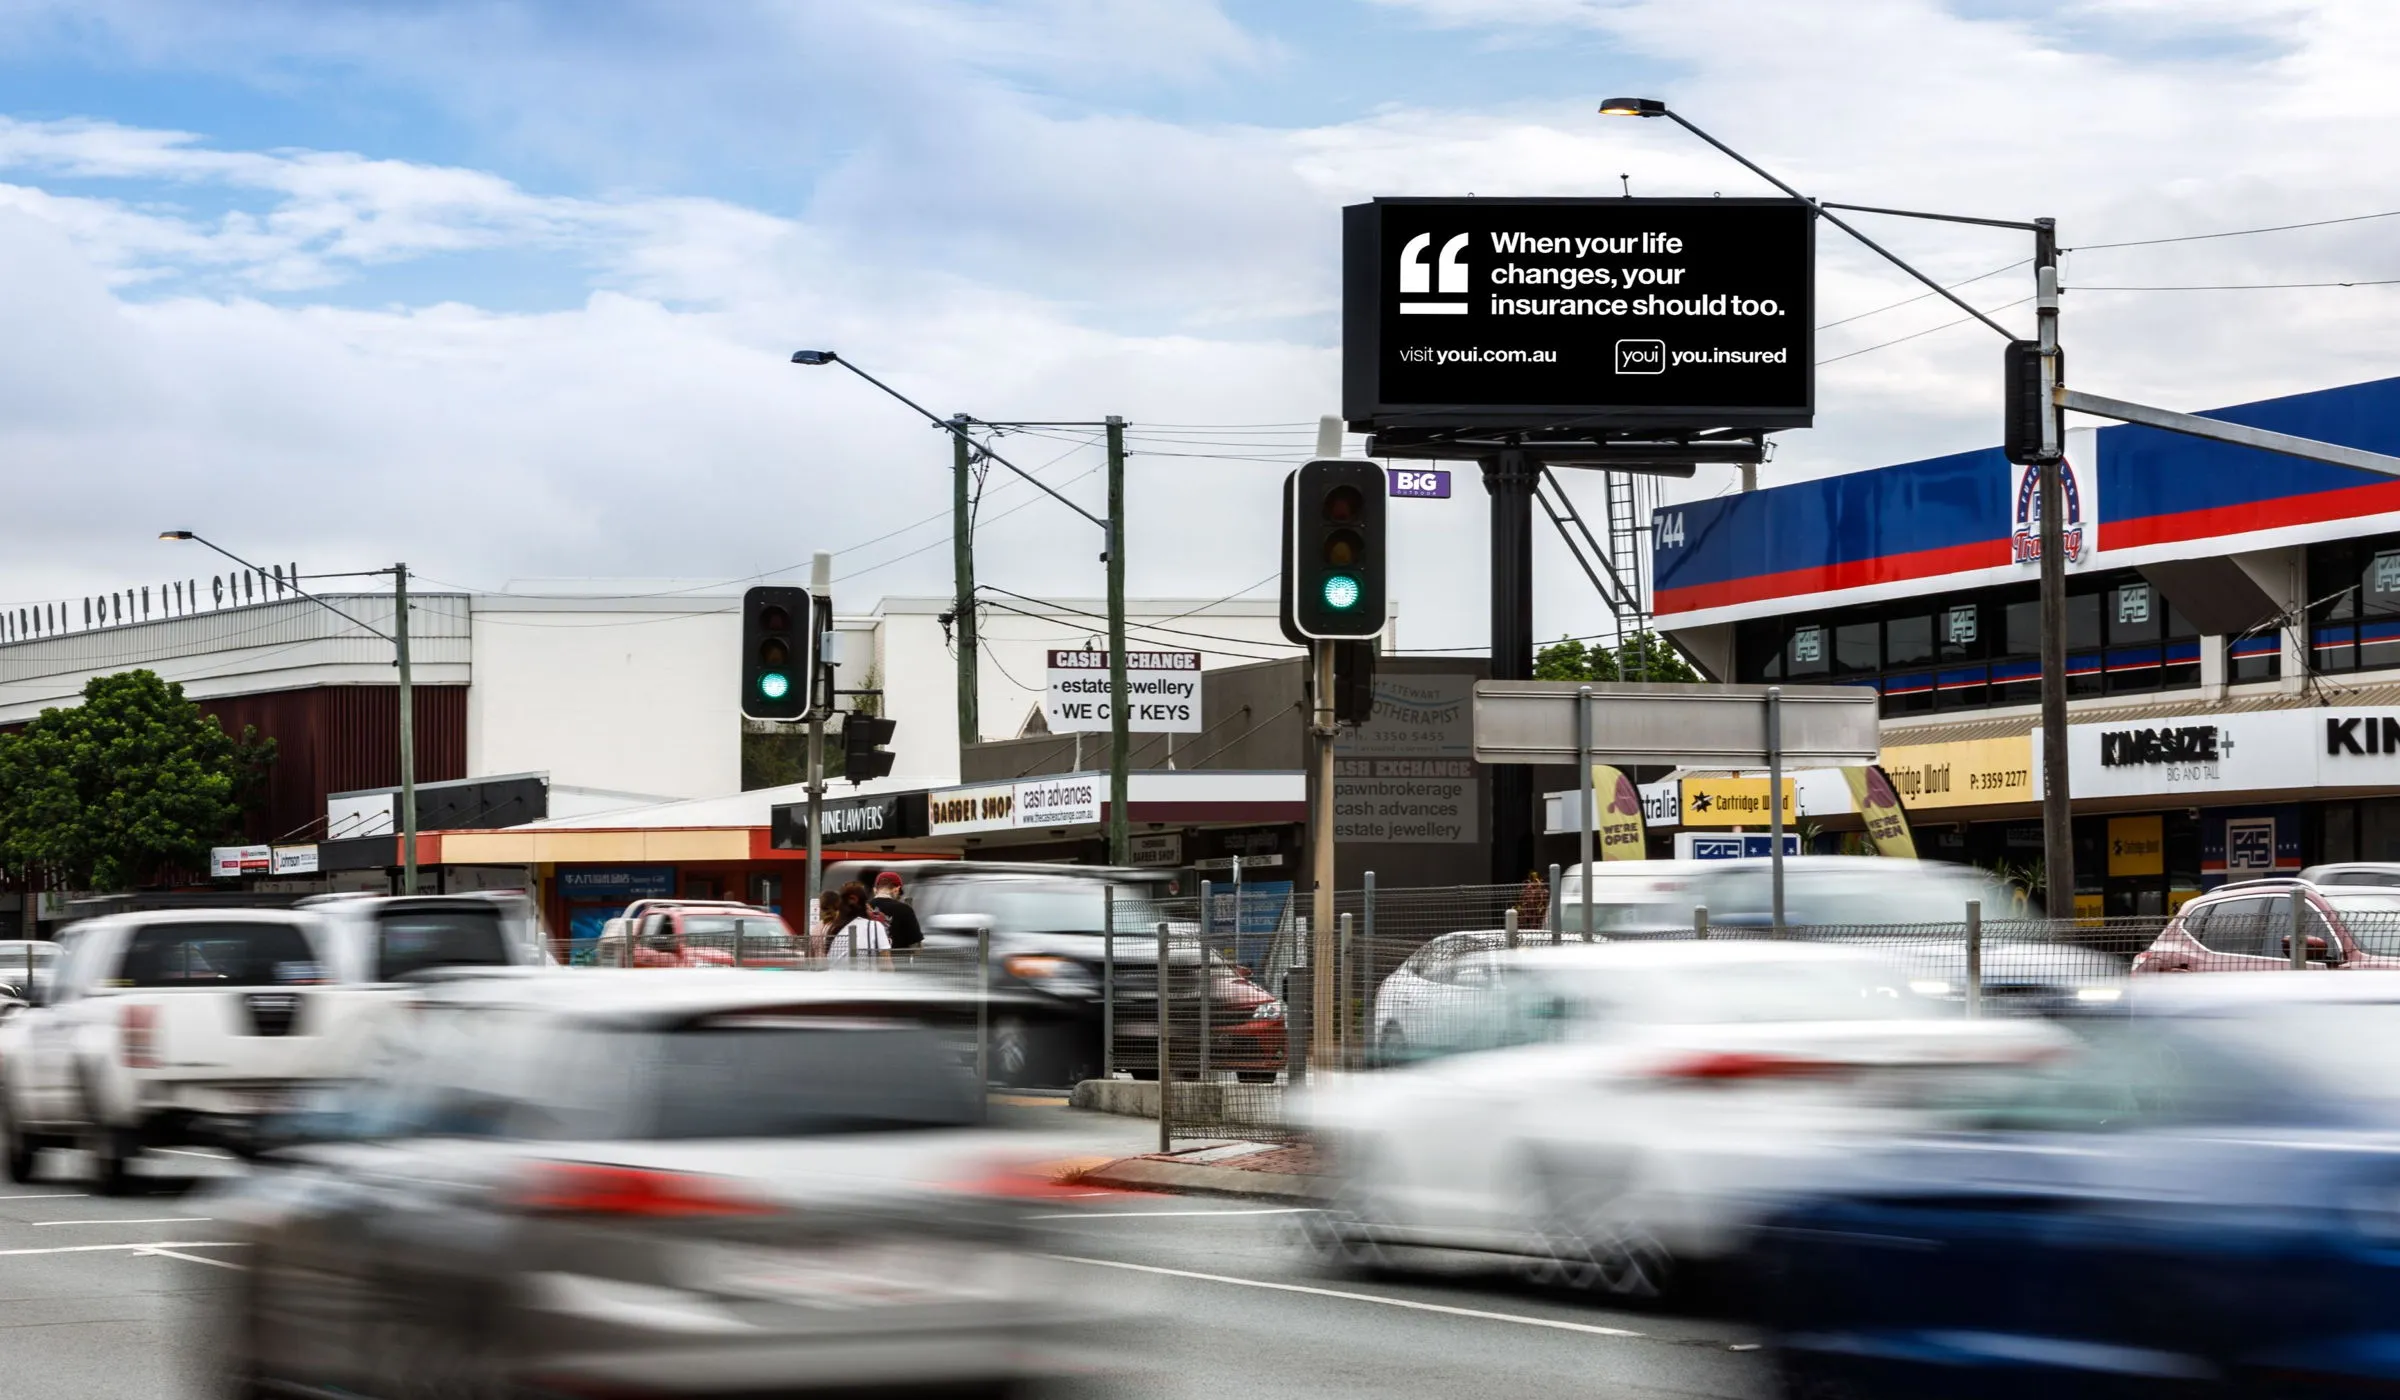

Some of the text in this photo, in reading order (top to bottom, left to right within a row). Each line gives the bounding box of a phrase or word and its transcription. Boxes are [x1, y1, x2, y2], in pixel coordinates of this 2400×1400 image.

[1491, 232, 1683, 258] When your life
[1491, 264, 1685, 289] changes, your
[1491, 294, 1785, 316] insurance should too.
[1400, 347, 1556, 365] visit youi.com.au
[1622, 346, 1658, 368] youi
[1672, 347, 1787, 365] you.insured
[1653, 511, 1685, 550] 744
[1056, 652, 1195, 669] CASH CHANGE
[1061, 679, 1194, 698] estate ewellery
[1391, 683, 1441, 700] STEWART
[1062, 704, 1190, 720] WE CT KEYS
[1373, 701, 1460, 725] OTHERAPIST
[1375, 731, 1408, 742] 3350
[1412, 731, 1445, 742] 5455
[1334, 761, 1471, 777] ASH EXCHANGE
[1924, 762, 1950, 793] World
[1970, 773, 1979, 790] P:
[1981, 772, 2003, 790] 3359
[2005, 770, 2027, 787] 2277
[2167, 766, 2220, 781] BIG AND TALL
[1024, 782, 1092, 809] cash advances
[1334, 781, 1462, 799] pawnbrokerage
[933, 796, 1012, 825] BARBER SHOP
[1335, 801, 1458, 816] cash advances
[1645, 790, 1677, 819] tralia
[1716, 795, 1759, 813] Cartridge
[842, 807, 883, 832] LAWYERS
[1335, 822, 1461, 839] estate jewellery
[1603, 823, 1638, 835] WE'RE
[1604, 833, 1639, 846] OPEN
